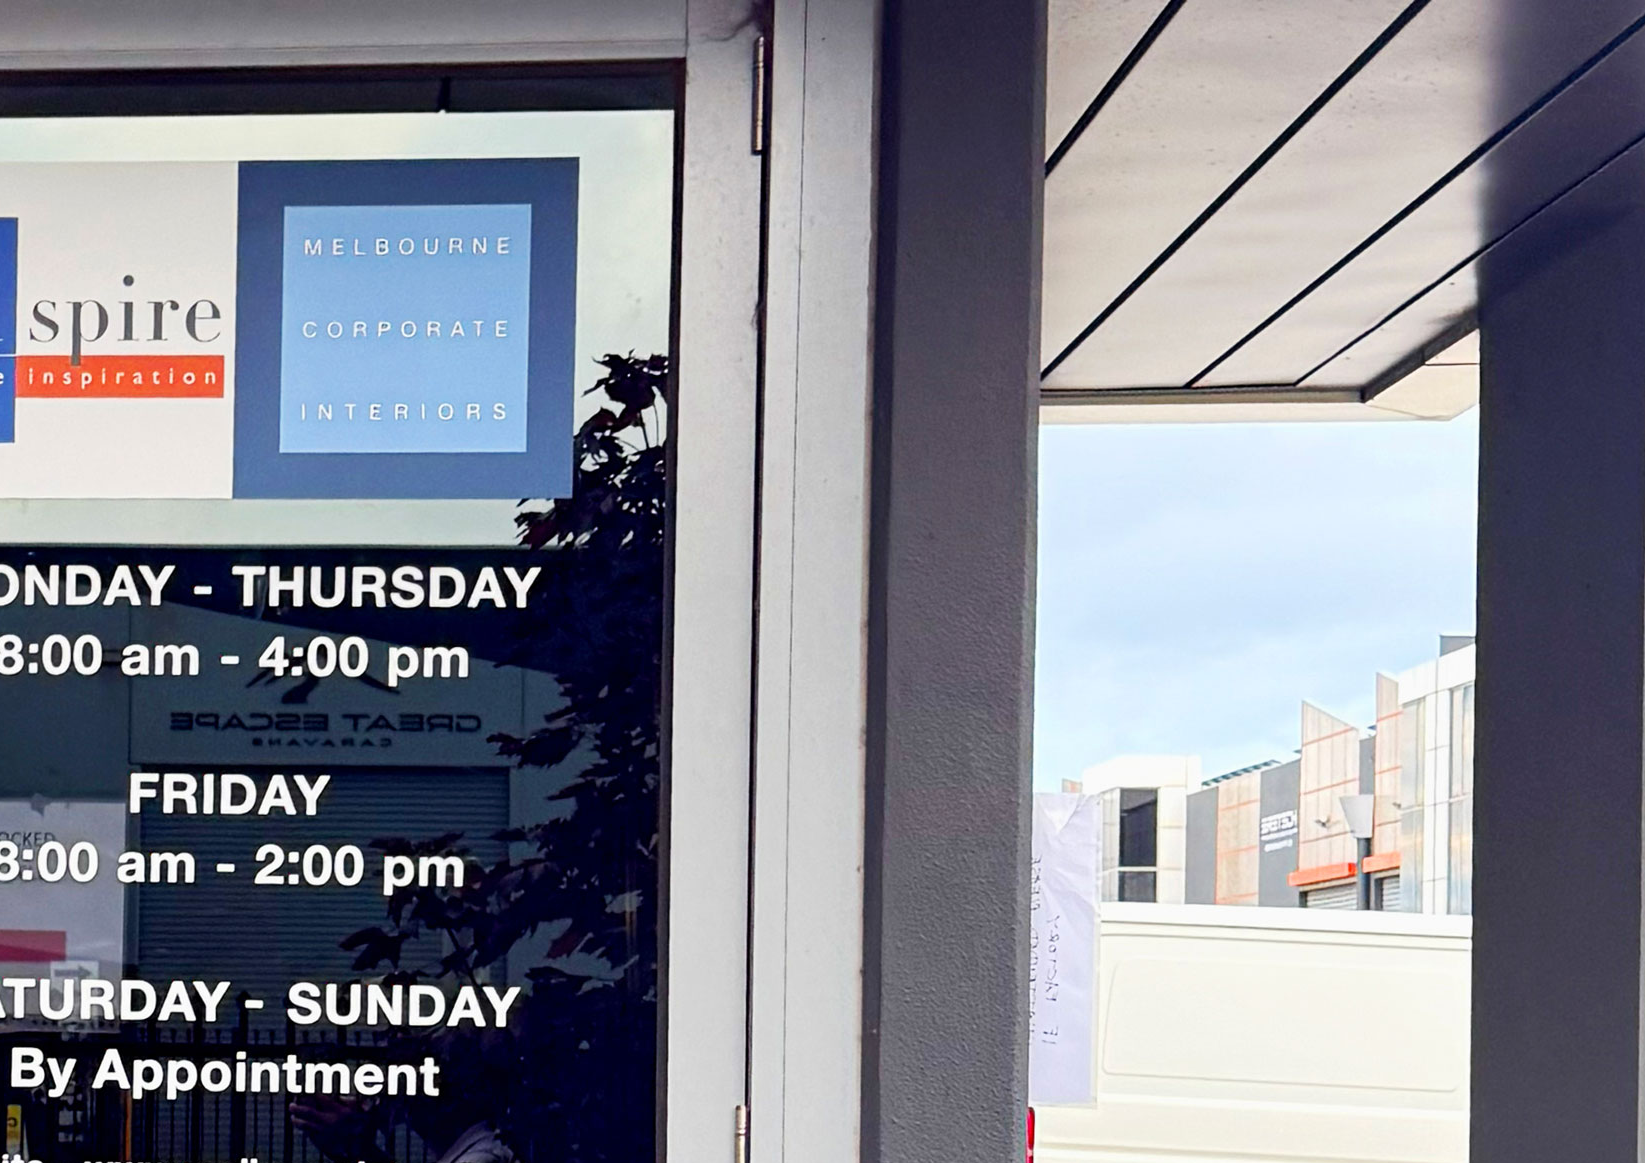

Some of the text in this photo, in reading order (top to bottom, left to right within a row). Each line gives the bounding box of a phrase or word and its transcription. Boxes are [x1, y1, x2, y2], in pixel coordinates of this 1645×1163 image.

[304, 236, 510, 256] MELBOURNE
[301, 319, 508, 339] CORPORATE
[28, 367, 216, 390] inspiration
[301, 402, 508, 421] INTERIORS
[193, 585, 213, 595] -
[231, 565, 542, 609] THURSDAY
[121, 644, 200, 676] am
[220, 655, 240, 665] -
[258, 635, 369, 678] 4:00
[387, 646, 469, 687] pm
[129, 772, 331, 816] FRIDAY
[116, 851, 195, 884] am
[216, 863, 236, 873] -
[254, 843, 365, 886] 2:00
[383, 855, 464, 896] pm
[244, 999, 264, 1009] -
[287, 982, 521, 1028] SUNDAY
[10, 1047, 440, 1100] By Appointment
